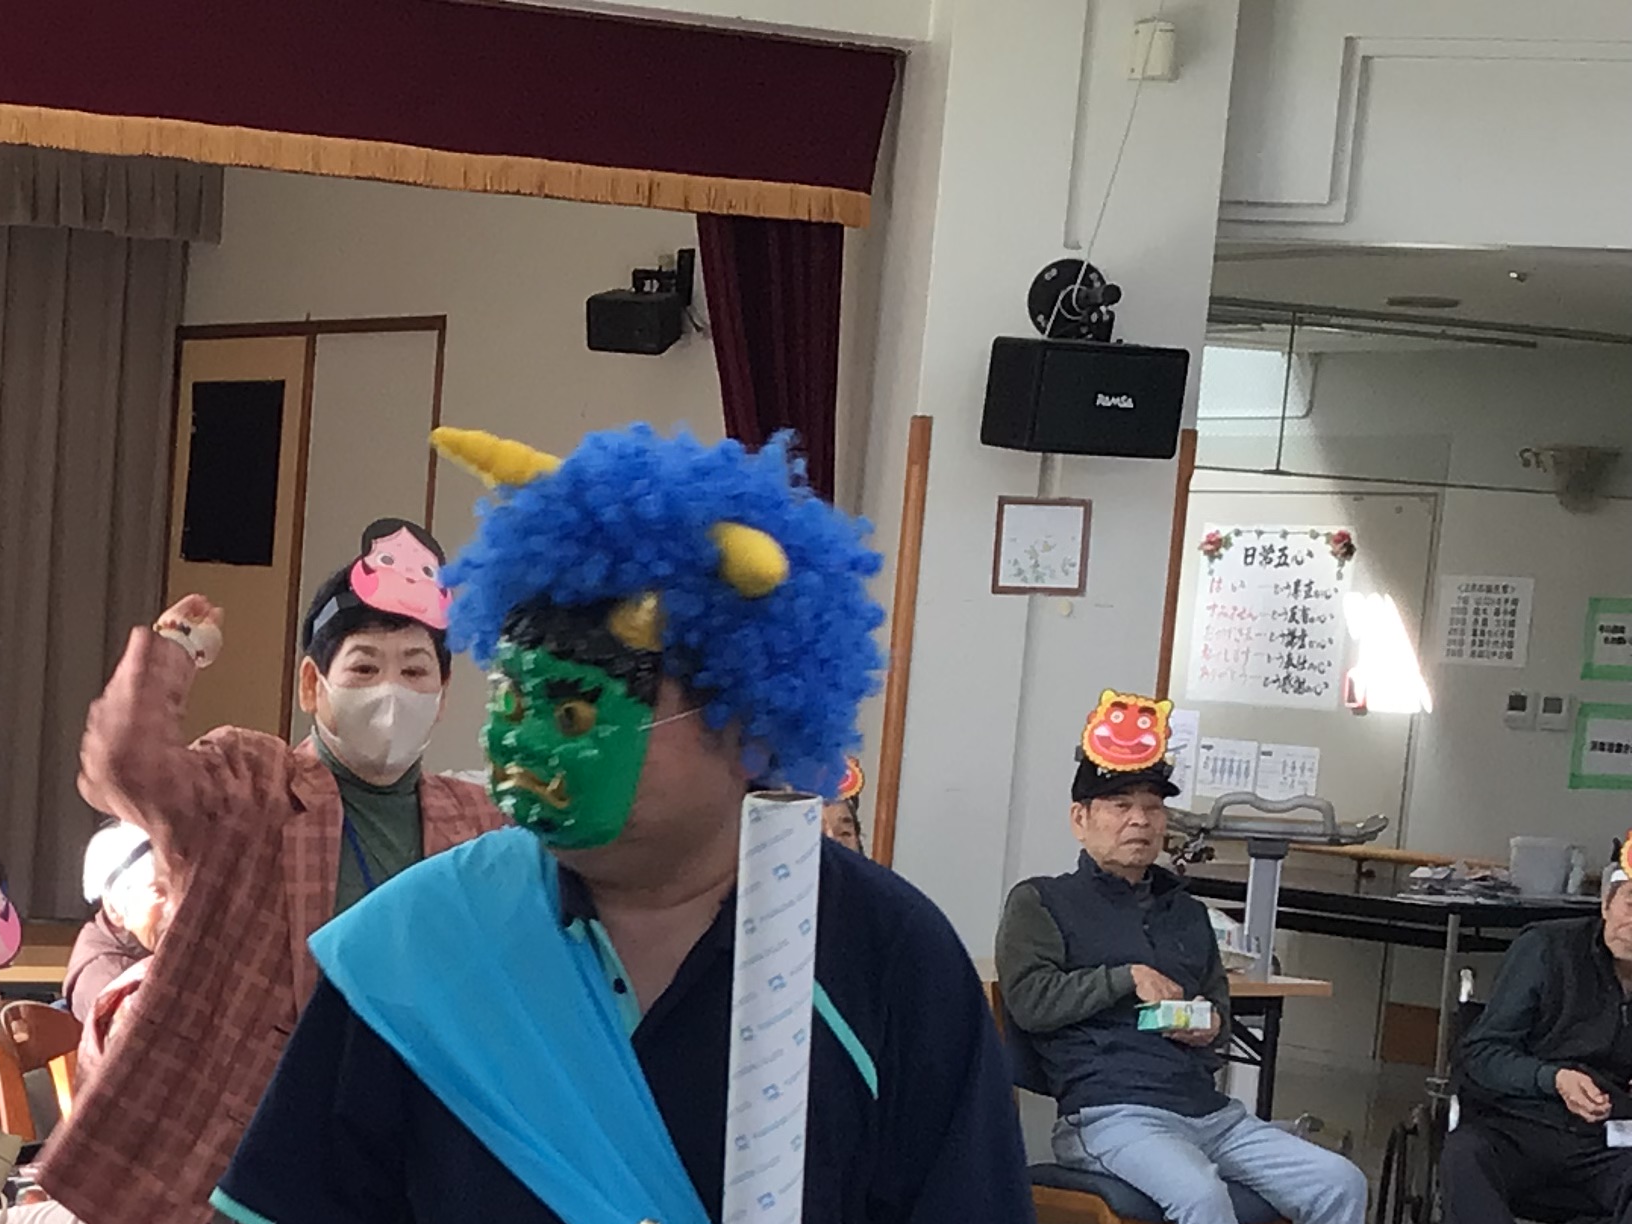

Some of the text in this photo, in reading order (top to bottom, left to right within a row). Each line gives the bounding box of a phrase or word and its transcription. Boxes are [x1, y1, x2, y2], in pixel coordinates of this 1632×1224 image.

[1096, 393, 1134, 409] RAMSA
[1243, 543, 1314, 568] 日常五心
